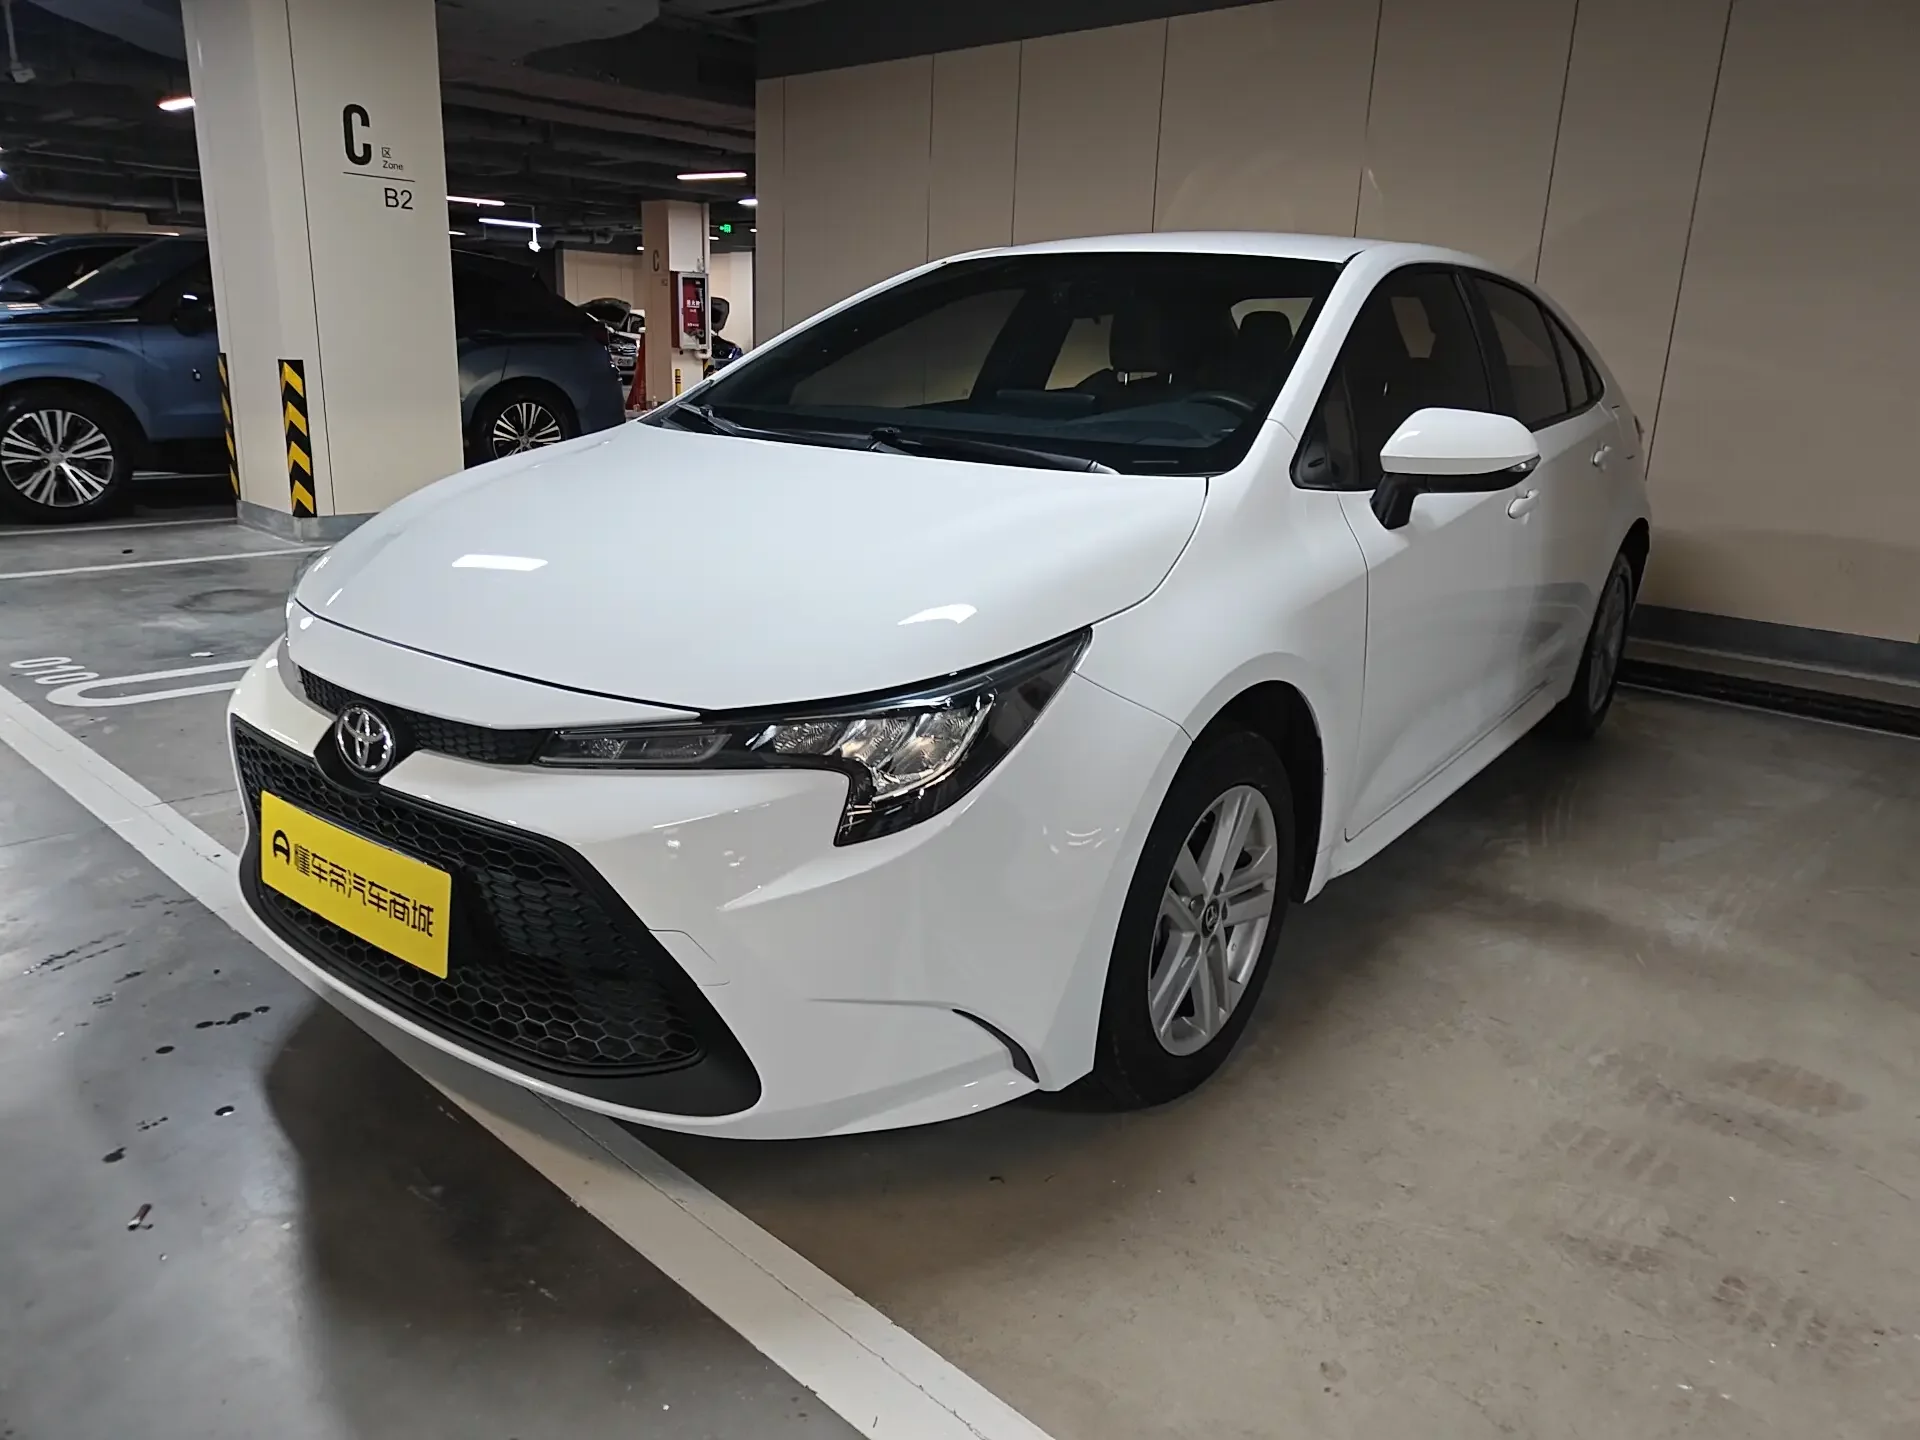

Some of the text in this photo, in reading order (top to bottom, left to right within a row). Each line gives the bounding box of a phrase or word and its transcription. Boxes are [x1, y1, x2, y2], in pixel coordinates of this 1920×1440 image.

[343, 103, 372, 166] C
[381, 147, 392, 159] 区
[382, 160, 404, 171] Zone
[384, 187, 414, 210] B2
[652, 249, 660, 272] C
[294, 843, 435, 938] 懂车帝汽车商城
